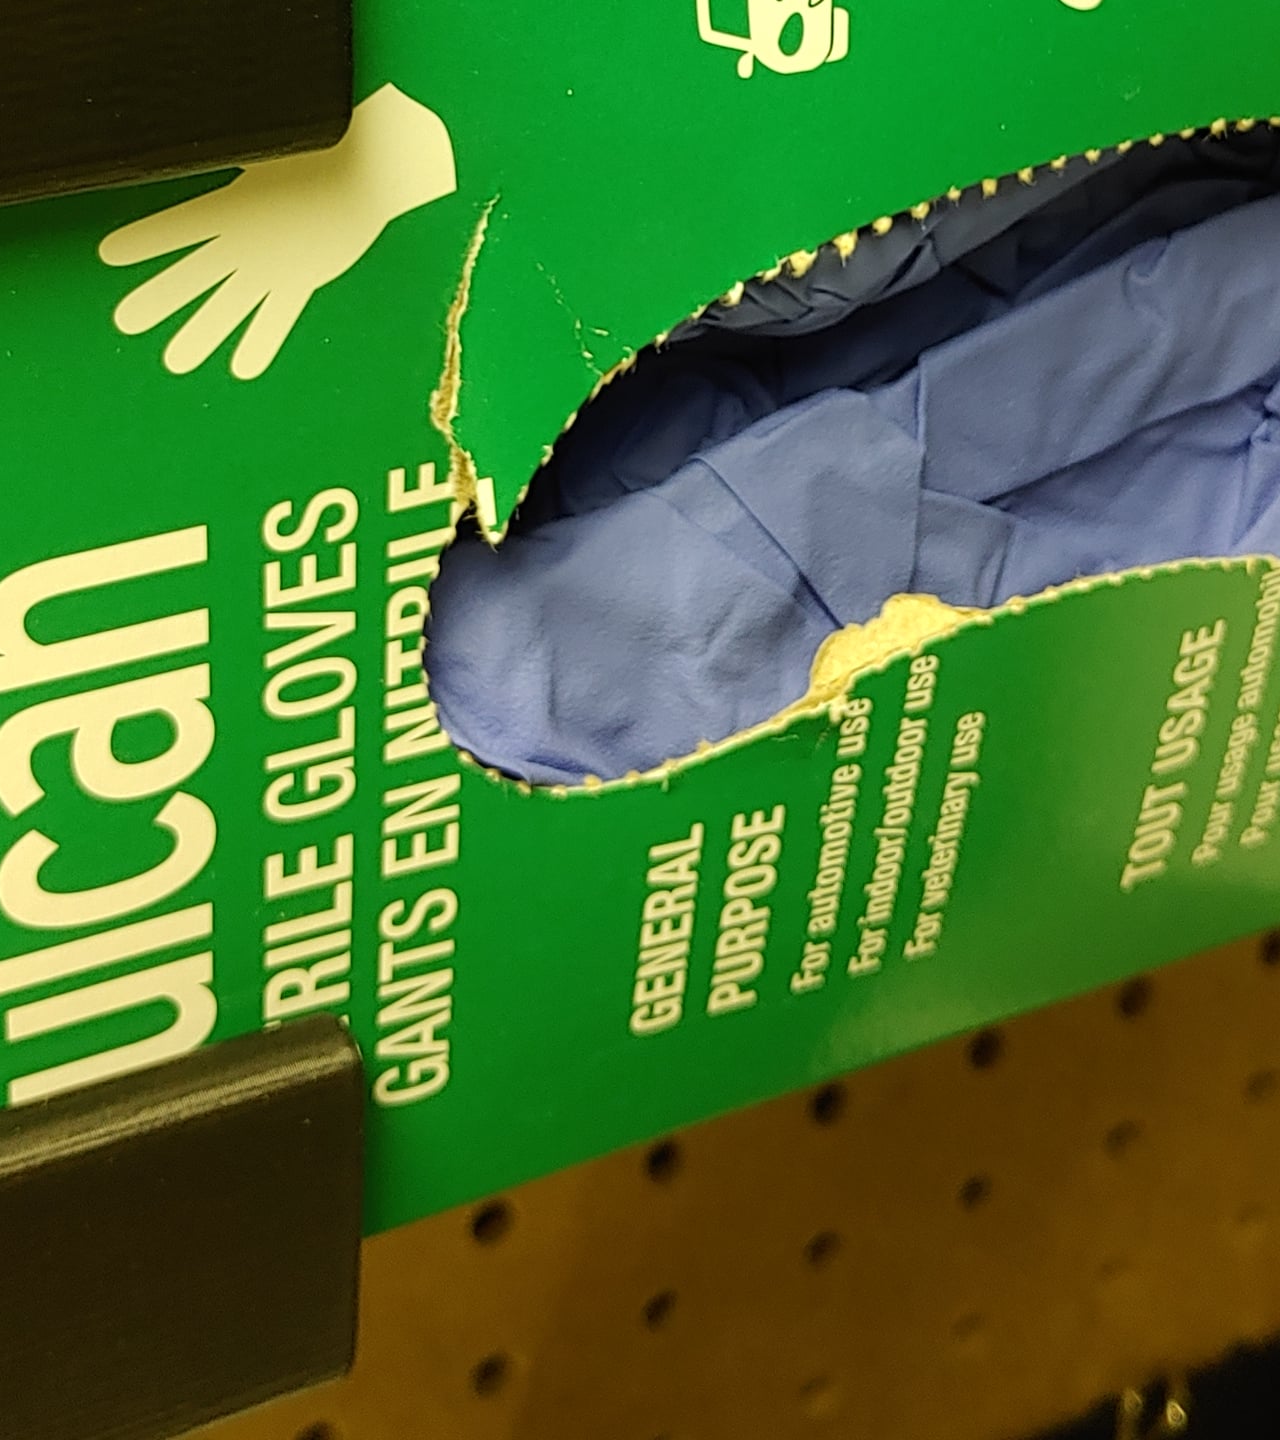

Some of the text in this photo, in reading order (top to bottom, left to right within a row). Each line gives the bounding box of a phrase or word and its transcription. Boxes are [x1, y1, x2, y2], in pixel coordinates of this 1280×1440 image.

[262, 487, 359, 1028] RILE GLOVES
[381, 773, 461, 877] EN
[790, 698, 872, 992] For automotive use
[847, 655, 939, 974] For indoor/outdoor use
[903, 712, 985, 958] For veterinary use
[1120, 619, 1226, 888] TOUT USAGE
[1191, 802, 1233, 865] Pour
[1215, 713, 1261, 797] usage
[374, 888, 458, 1104] GANTS
[630, 822, 703, 1032] GENERAL
[707, 804, 785, 1013] PURPOSE
